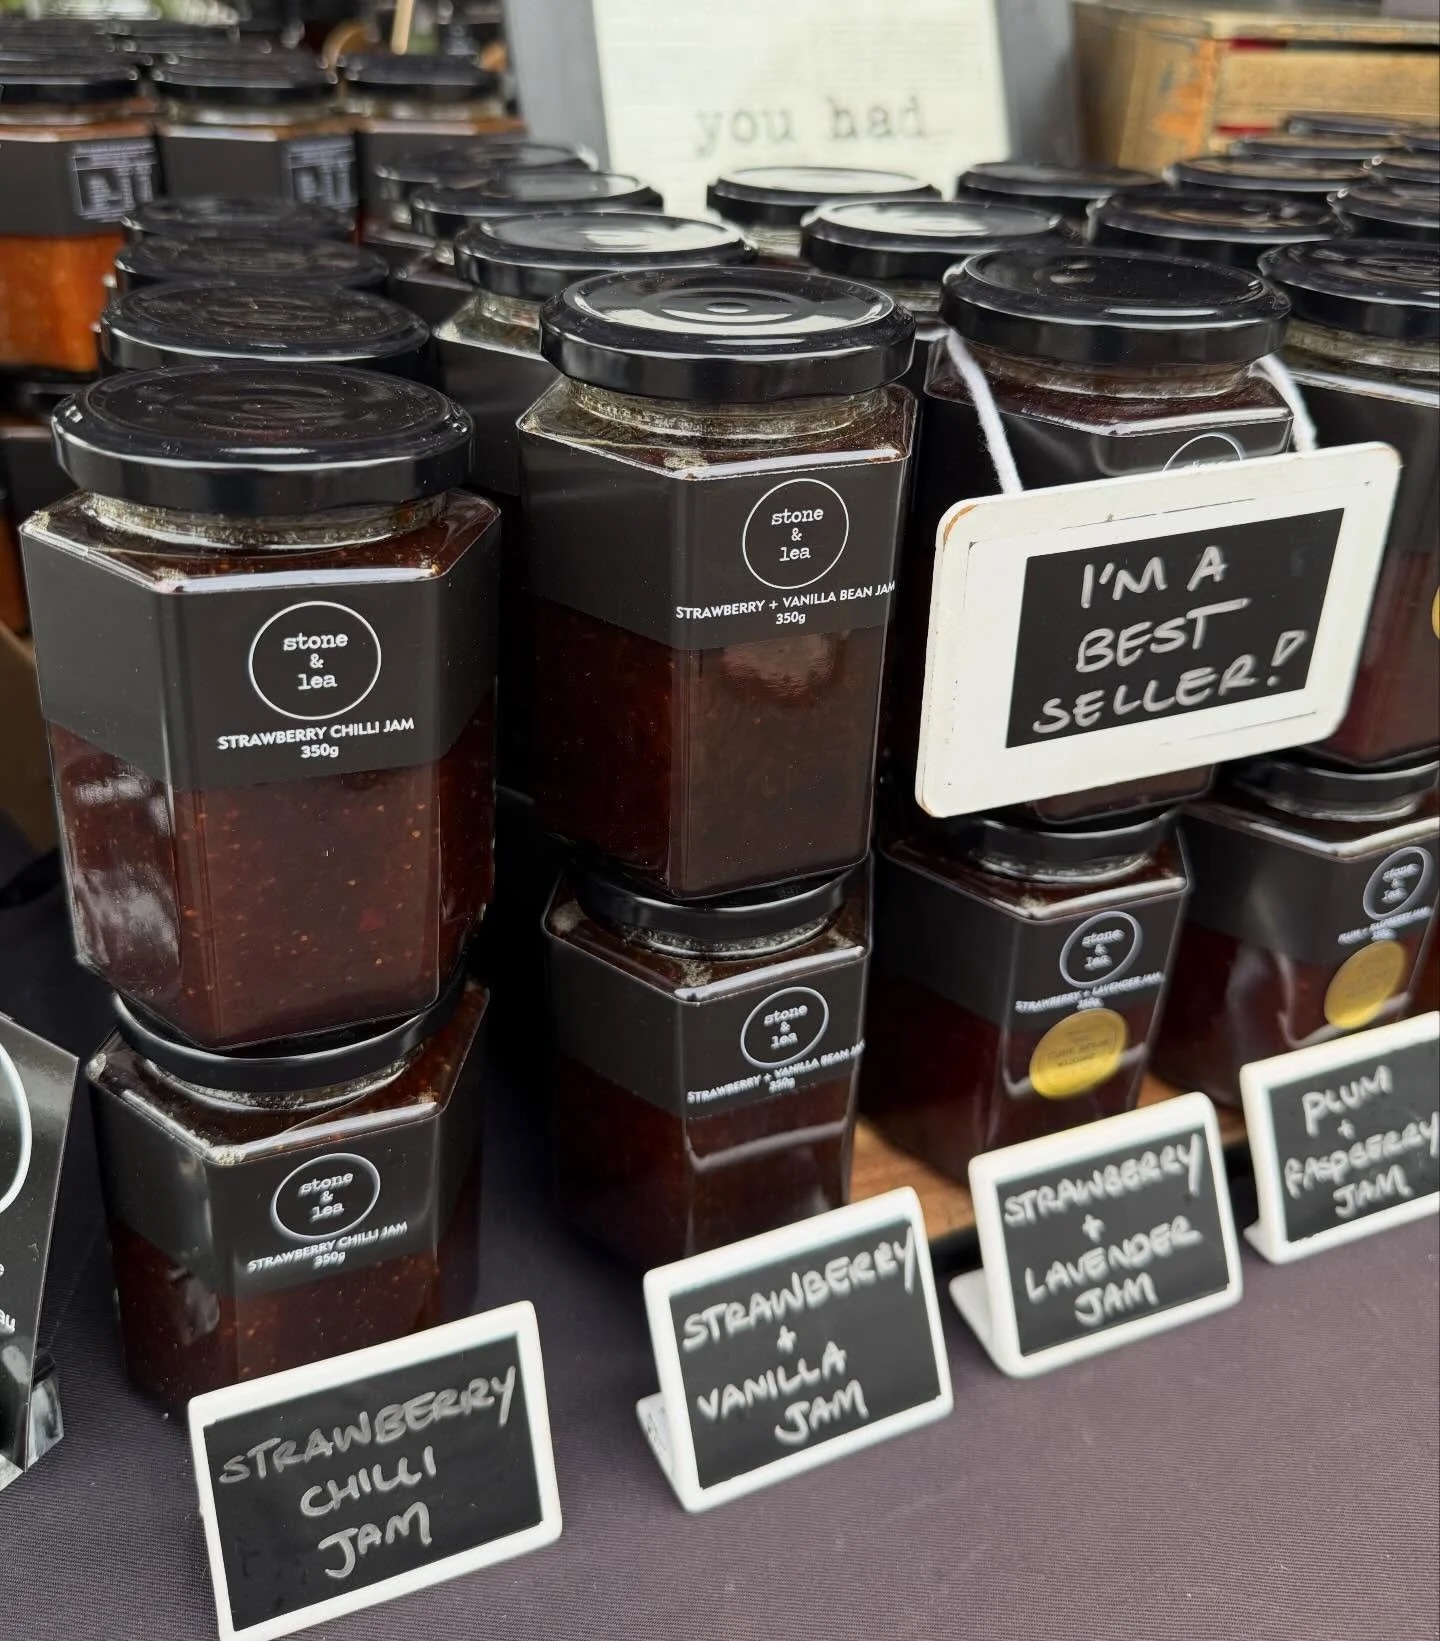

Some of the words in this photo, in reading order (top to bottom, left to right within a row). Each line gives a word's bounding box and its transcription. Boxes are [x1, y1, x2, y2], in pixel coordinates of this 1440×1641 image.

[695, 109, 797, 157] you
[826, 96, 929, 142] had
[771, 508, 824, 525] stone
[791, 527, 802, 541] &
[779, 547, 811, 562] lea
[1080, 556, 1168, 609] I'M
[1186, 545, 1229, 592] A
[675, 600, 765, 620] STRAWBERRY
[769, 600, 779, 610] +
[783, 591, 836, 609] VANILLA
[839, 585, 873, 601] BEAN
[875, 581, 896, 597] JAM
[775, 612, 806, 625] 350g
[283, 632, 348, 651] stone
[1075, 597, 1254, 673] BEST
[309, 653, 324, 669] &
[298, 674, 338, 690] lea
[1032, 629, 1309, 733] SELLER!
[217, 726, 327, 750] STRAWBERRY
[330, 721, 380, 739] CHILLI
[383, 717, 415, 733] JAM
[301, 743, 339, 759] 350g
[764, 1004, 808, 1026] stone
[770, 1032, 798, 1050] lea
[686, 1074, 762, 1104] STRAWBERRY
[774, 1058, 820, 1079] VANILLA
[820, 1048, 849, 1067] BEAN
[1302, 1064, 1394, 1137] PLUM
[1337, 1118, 1356, 1140] +
[299, 1172, 354, 1196] stone
[320, 1191, 334, 1204] &
[1003, 1133, 1202, 1228] STRAWBERRY
[1332, 1164, 1415, 1219] JAM
[310, 1202, 345, 1221] lea
[1082, 1213, 1105, 1243] +
[247, 1239, 336, 1272] STRAWBERRY
[335, 1229, 379, 1250] CHILLI
[379, 1221, 408, 1240] JAM
[313, 1251, 346, 1269] 350g
[1024, 1214, 1203, 1304] LAVENDER
[681, 1224, 916, 1351] STRAWBERRY
[1073, 1271, 1160, 1327] JAM
[776, 1324, 797, 1353] +
[697, 1340, 848, 1421] VANILLA
[218, 1366, 516, 1484] STRAWBERRY
[774, 1378, 870, 1446] JAM
[300, 1445, 437, 1518] CHILLI
[317, 1502, 434, 1580] JAM
